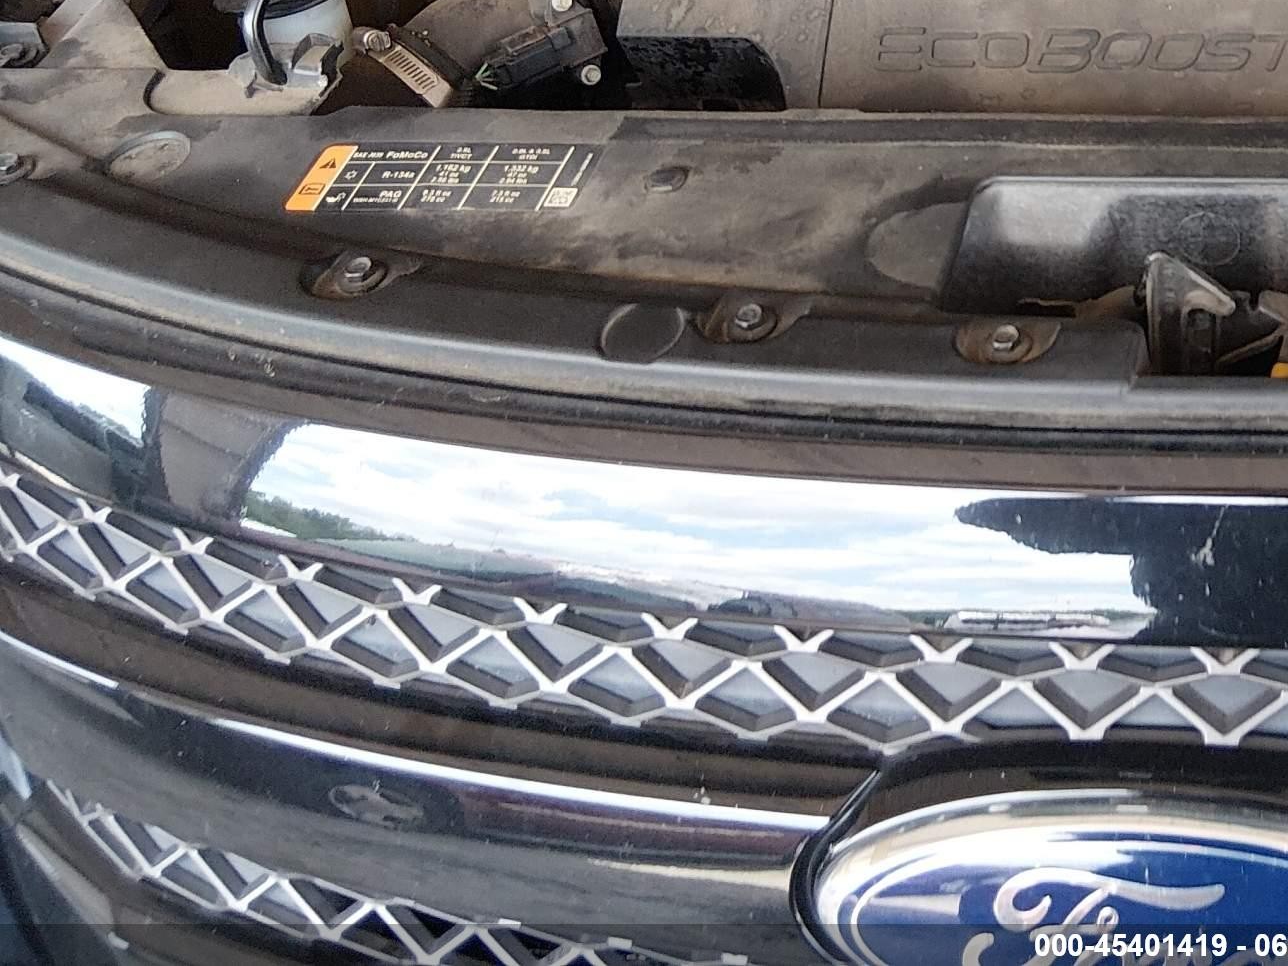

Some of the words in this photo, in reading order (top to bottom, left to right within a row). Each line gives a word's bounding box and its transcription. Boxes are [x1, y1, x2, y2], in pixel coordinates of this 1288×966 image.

[386, 150, 429, 159] FoMoCo
[459, 164, 471, 174] kg
[527, 165, 540, 174] kg
[382, 170, 416, 179] R-134a
[380, 190, 402, 198] PAG
